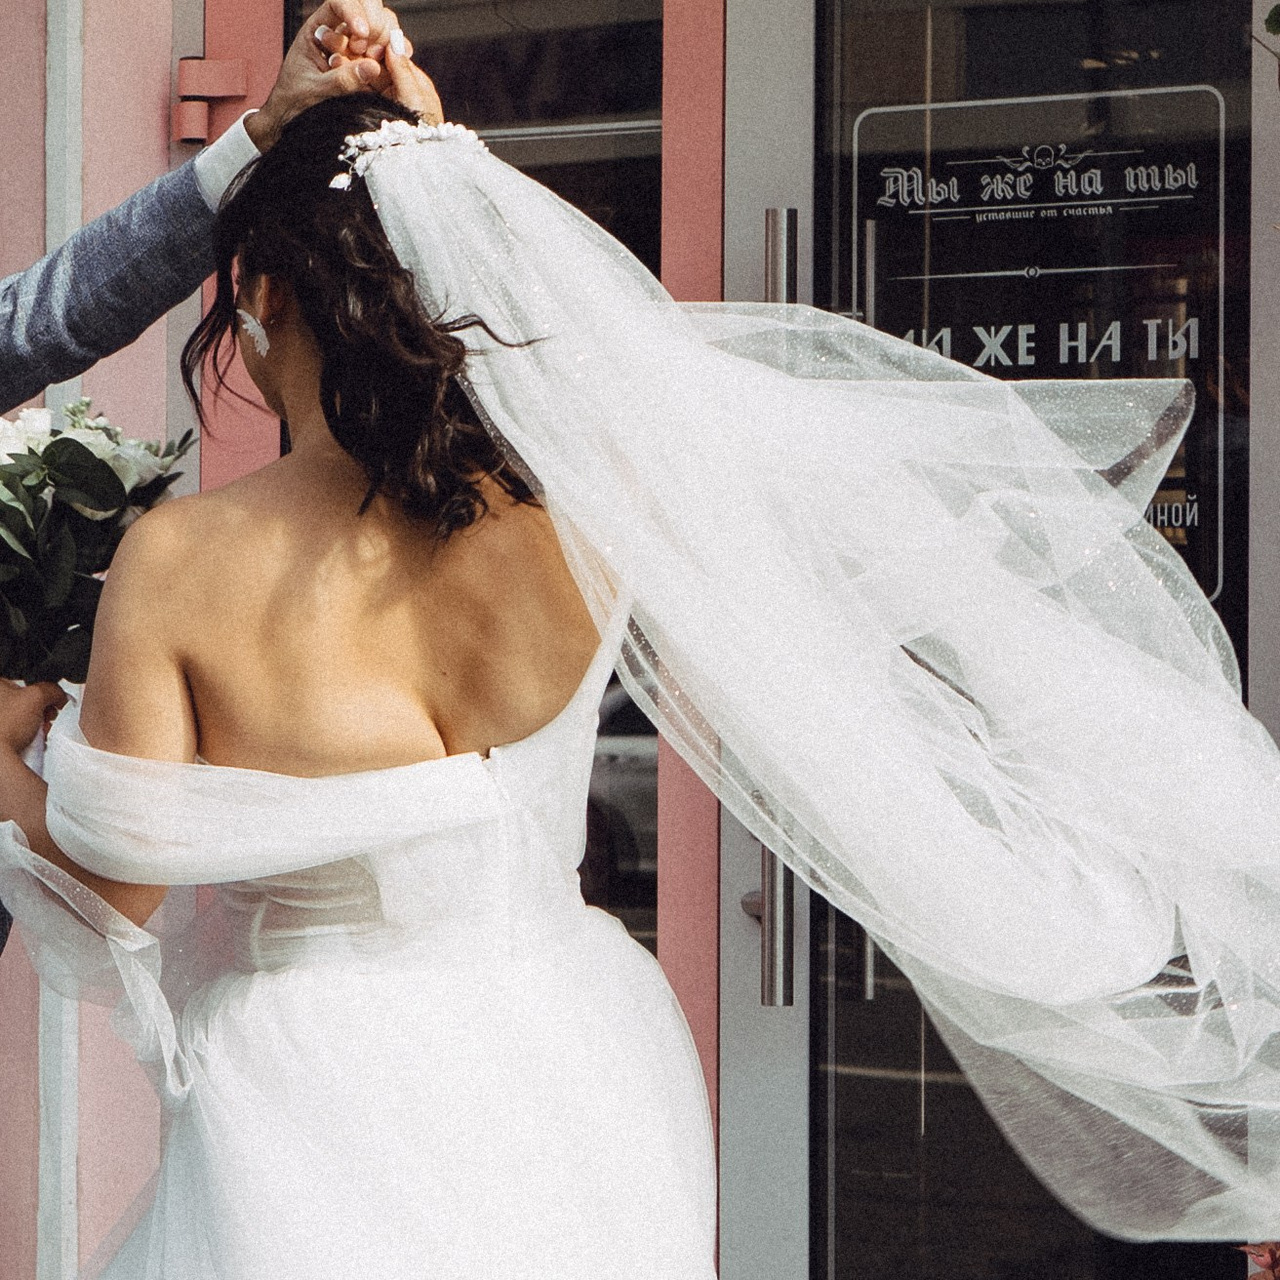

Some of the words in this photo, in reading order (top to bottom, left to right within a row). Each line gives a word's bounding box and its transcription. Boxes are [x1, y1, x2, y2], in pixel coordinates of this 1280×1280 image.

[876, 166, 961, 208] Мы
[980, 172, 1034, 202] же
[1054, 168, 1105, 197] на
[1124, 162, 1199, 194] ты
[1040, 207, 1058, 218] от
[1063, 205, 1113, 218] счастья
[973, 324, 1036, 367] ЖЕ
[1059, 320, 1121, 364] НА
[1143, 318, 1199, 362] ТЫ
